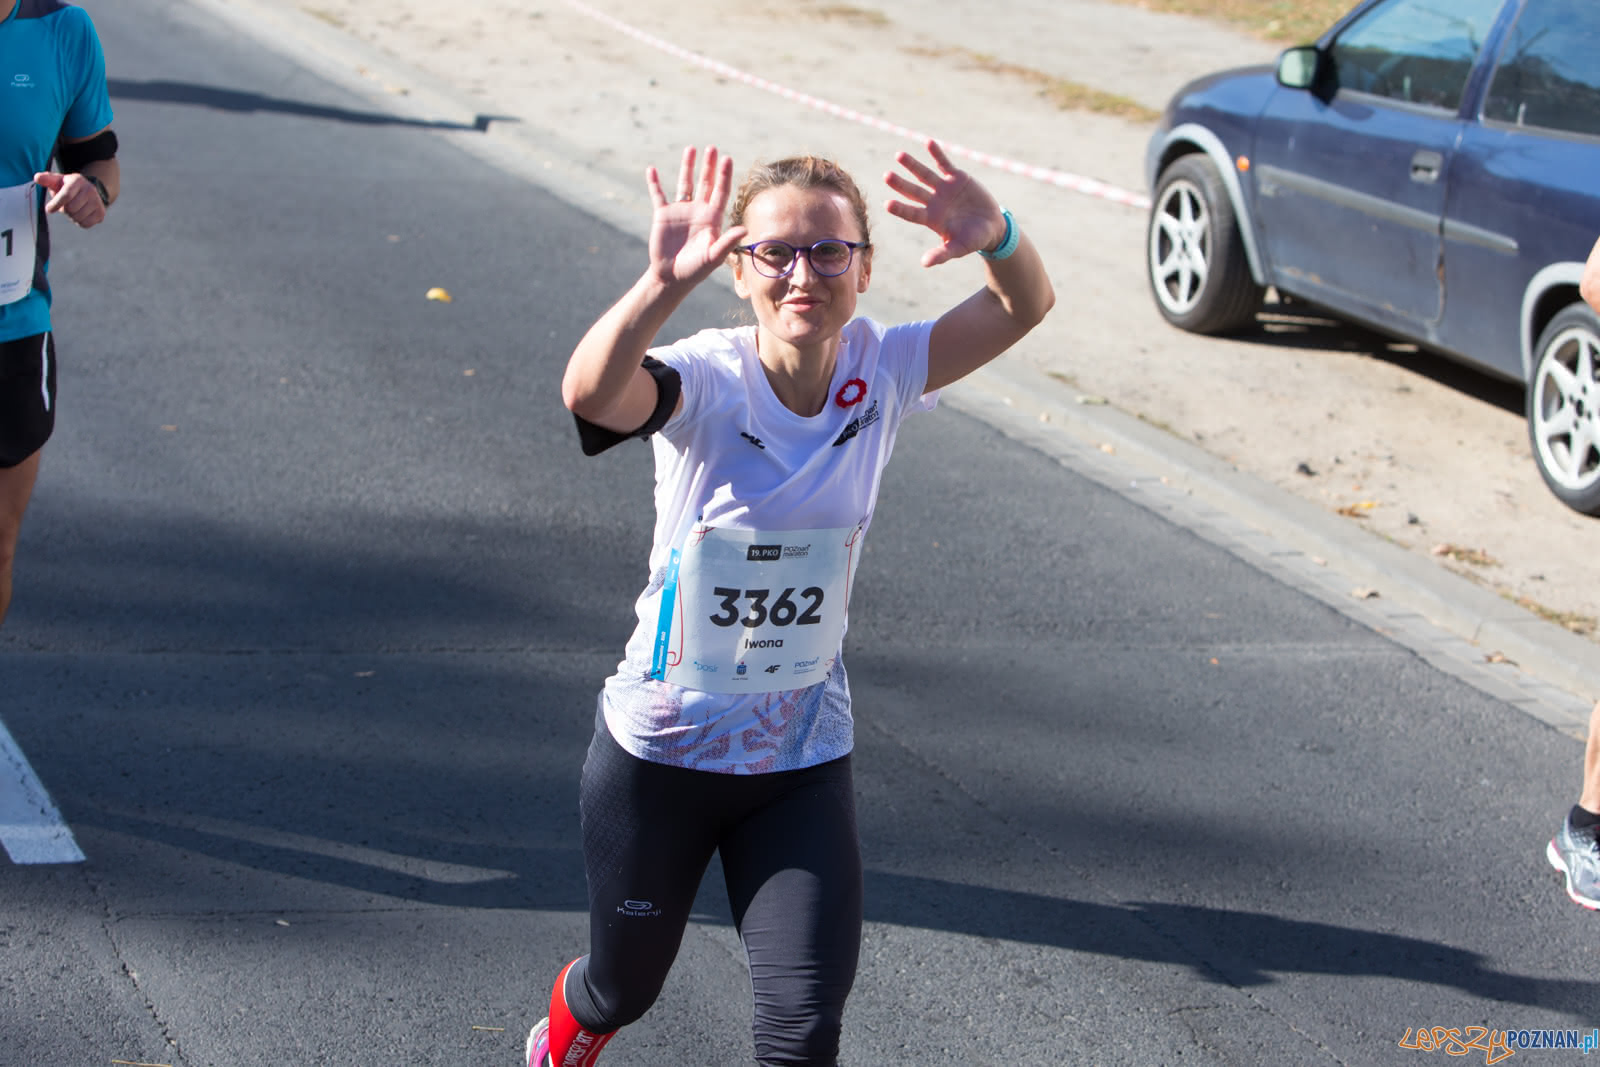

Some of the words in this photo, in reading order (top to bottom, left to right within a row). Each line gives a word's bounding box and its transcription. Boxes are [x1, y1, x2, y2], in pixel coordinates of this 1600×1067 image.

[762, 549, 779, 557] PKO
[709, 586, 825, 628] 3362
[744, 638, 784, 649] Iwona
